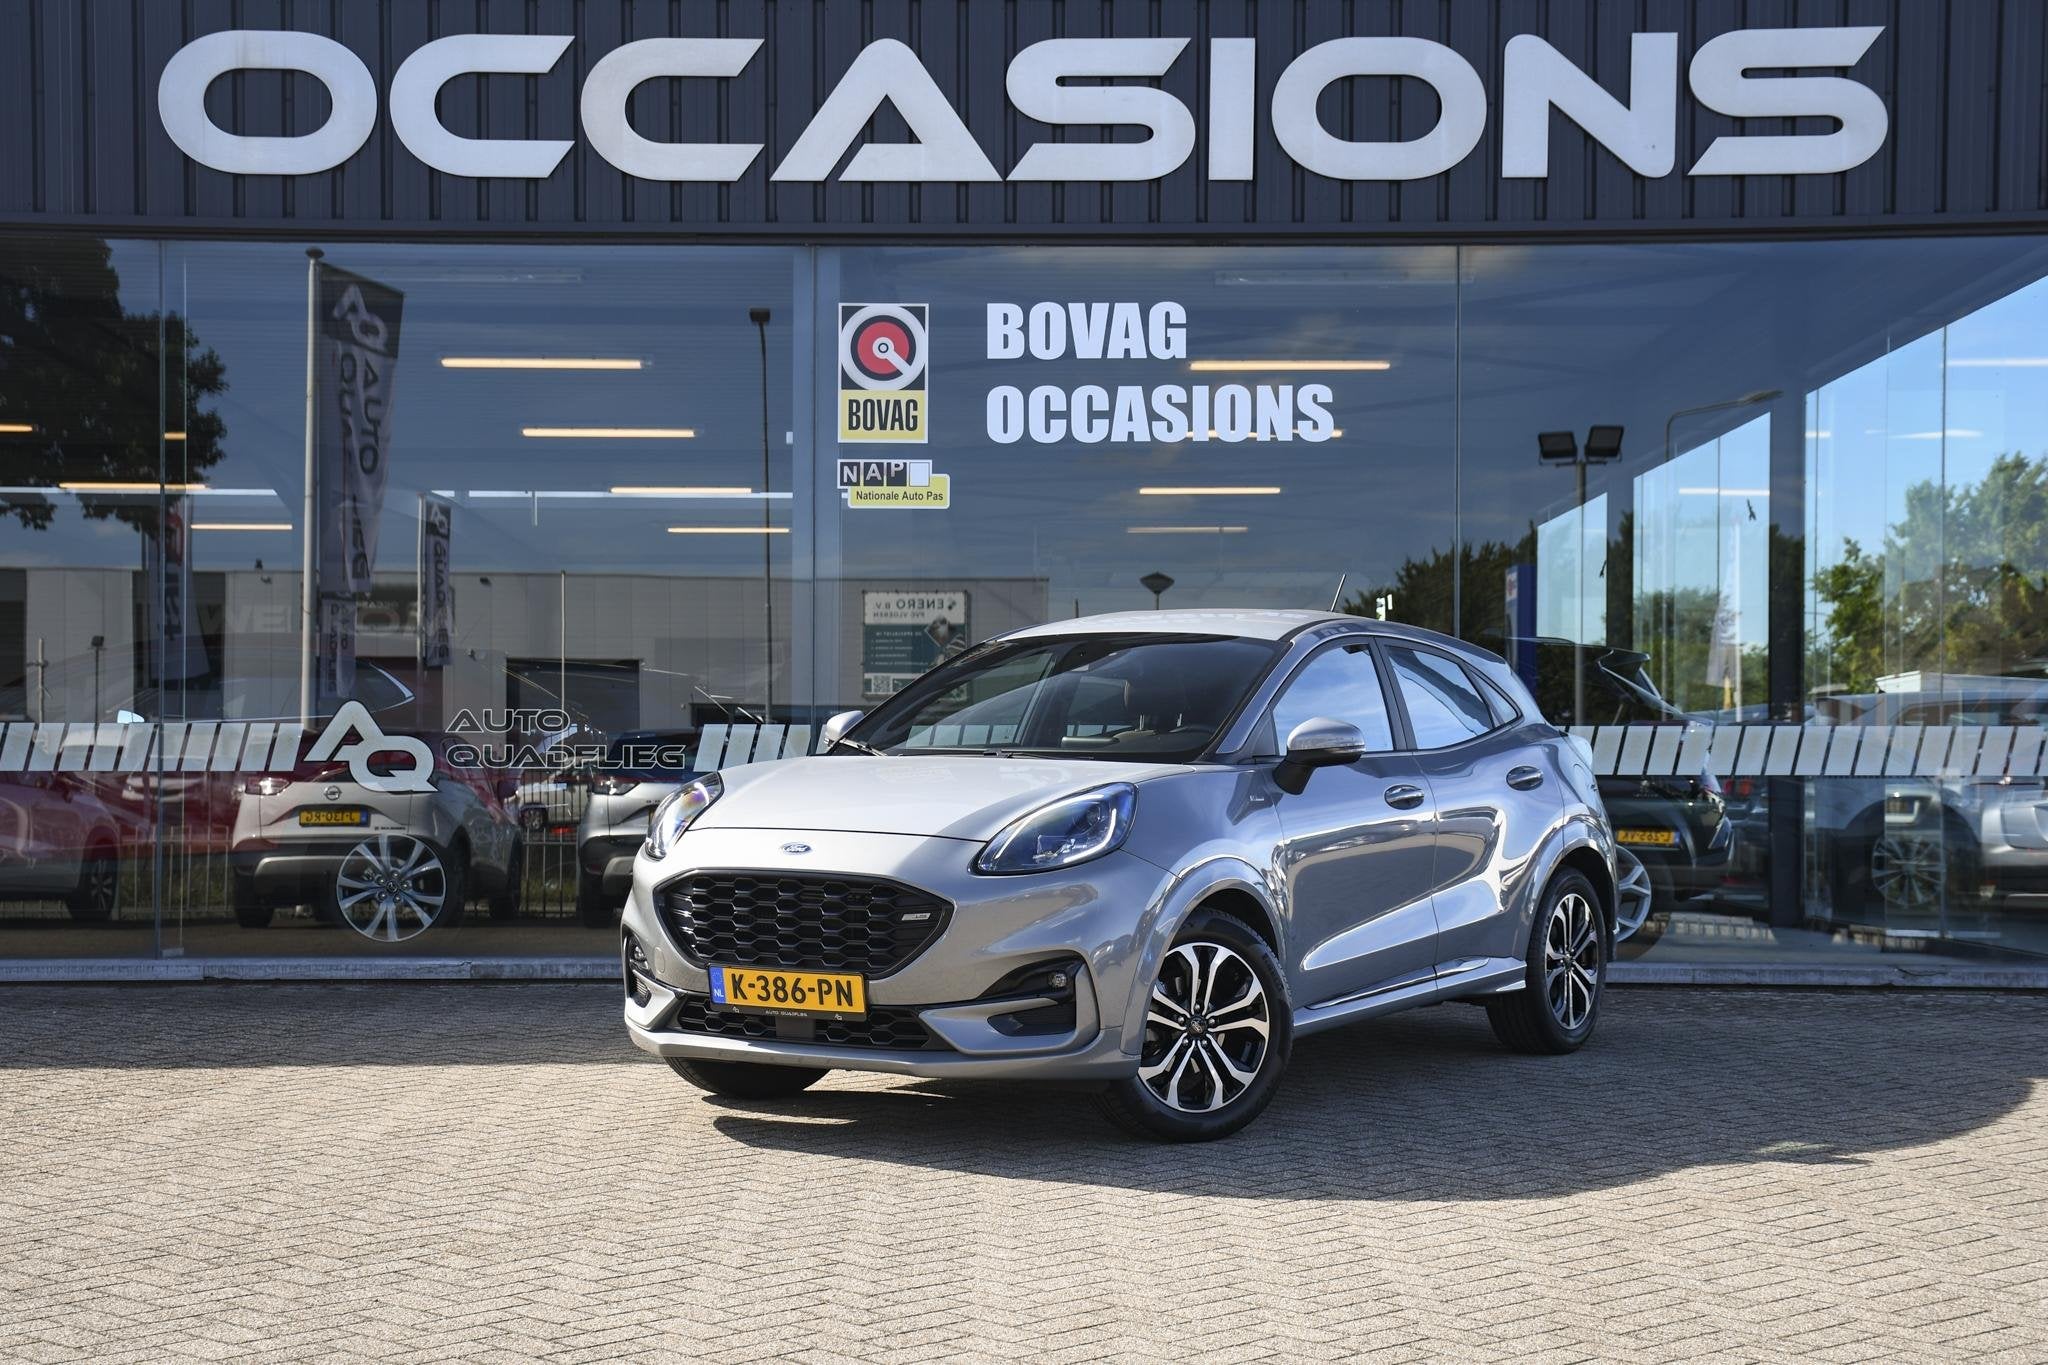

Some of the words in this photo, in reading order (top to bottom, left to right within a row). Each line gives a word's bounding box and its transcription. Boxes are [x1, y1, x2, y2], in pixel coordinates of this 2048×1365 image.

[158, 27, 1887, 181] OCCASIONS
[988, 302, 1187, 360] BOVAG
[848, 398, 918, 431] BOVAG
[987, 384, 1335, 443] OCCASIONS
[843, 461, 904, 483] NAP
[856, 491, 899, 501] Nationale
[902, 491, 924, 501] Auto
[926, 492, 943, 501] Pas
[445, 708, 571, 733] AUTO
[303, 700, 438, 792] AQ
[446, 744, 686, 770] QUADFLIEG
[714, 989, 724, 998] NL
[731, 973, 854, 1007] K-386-PN
